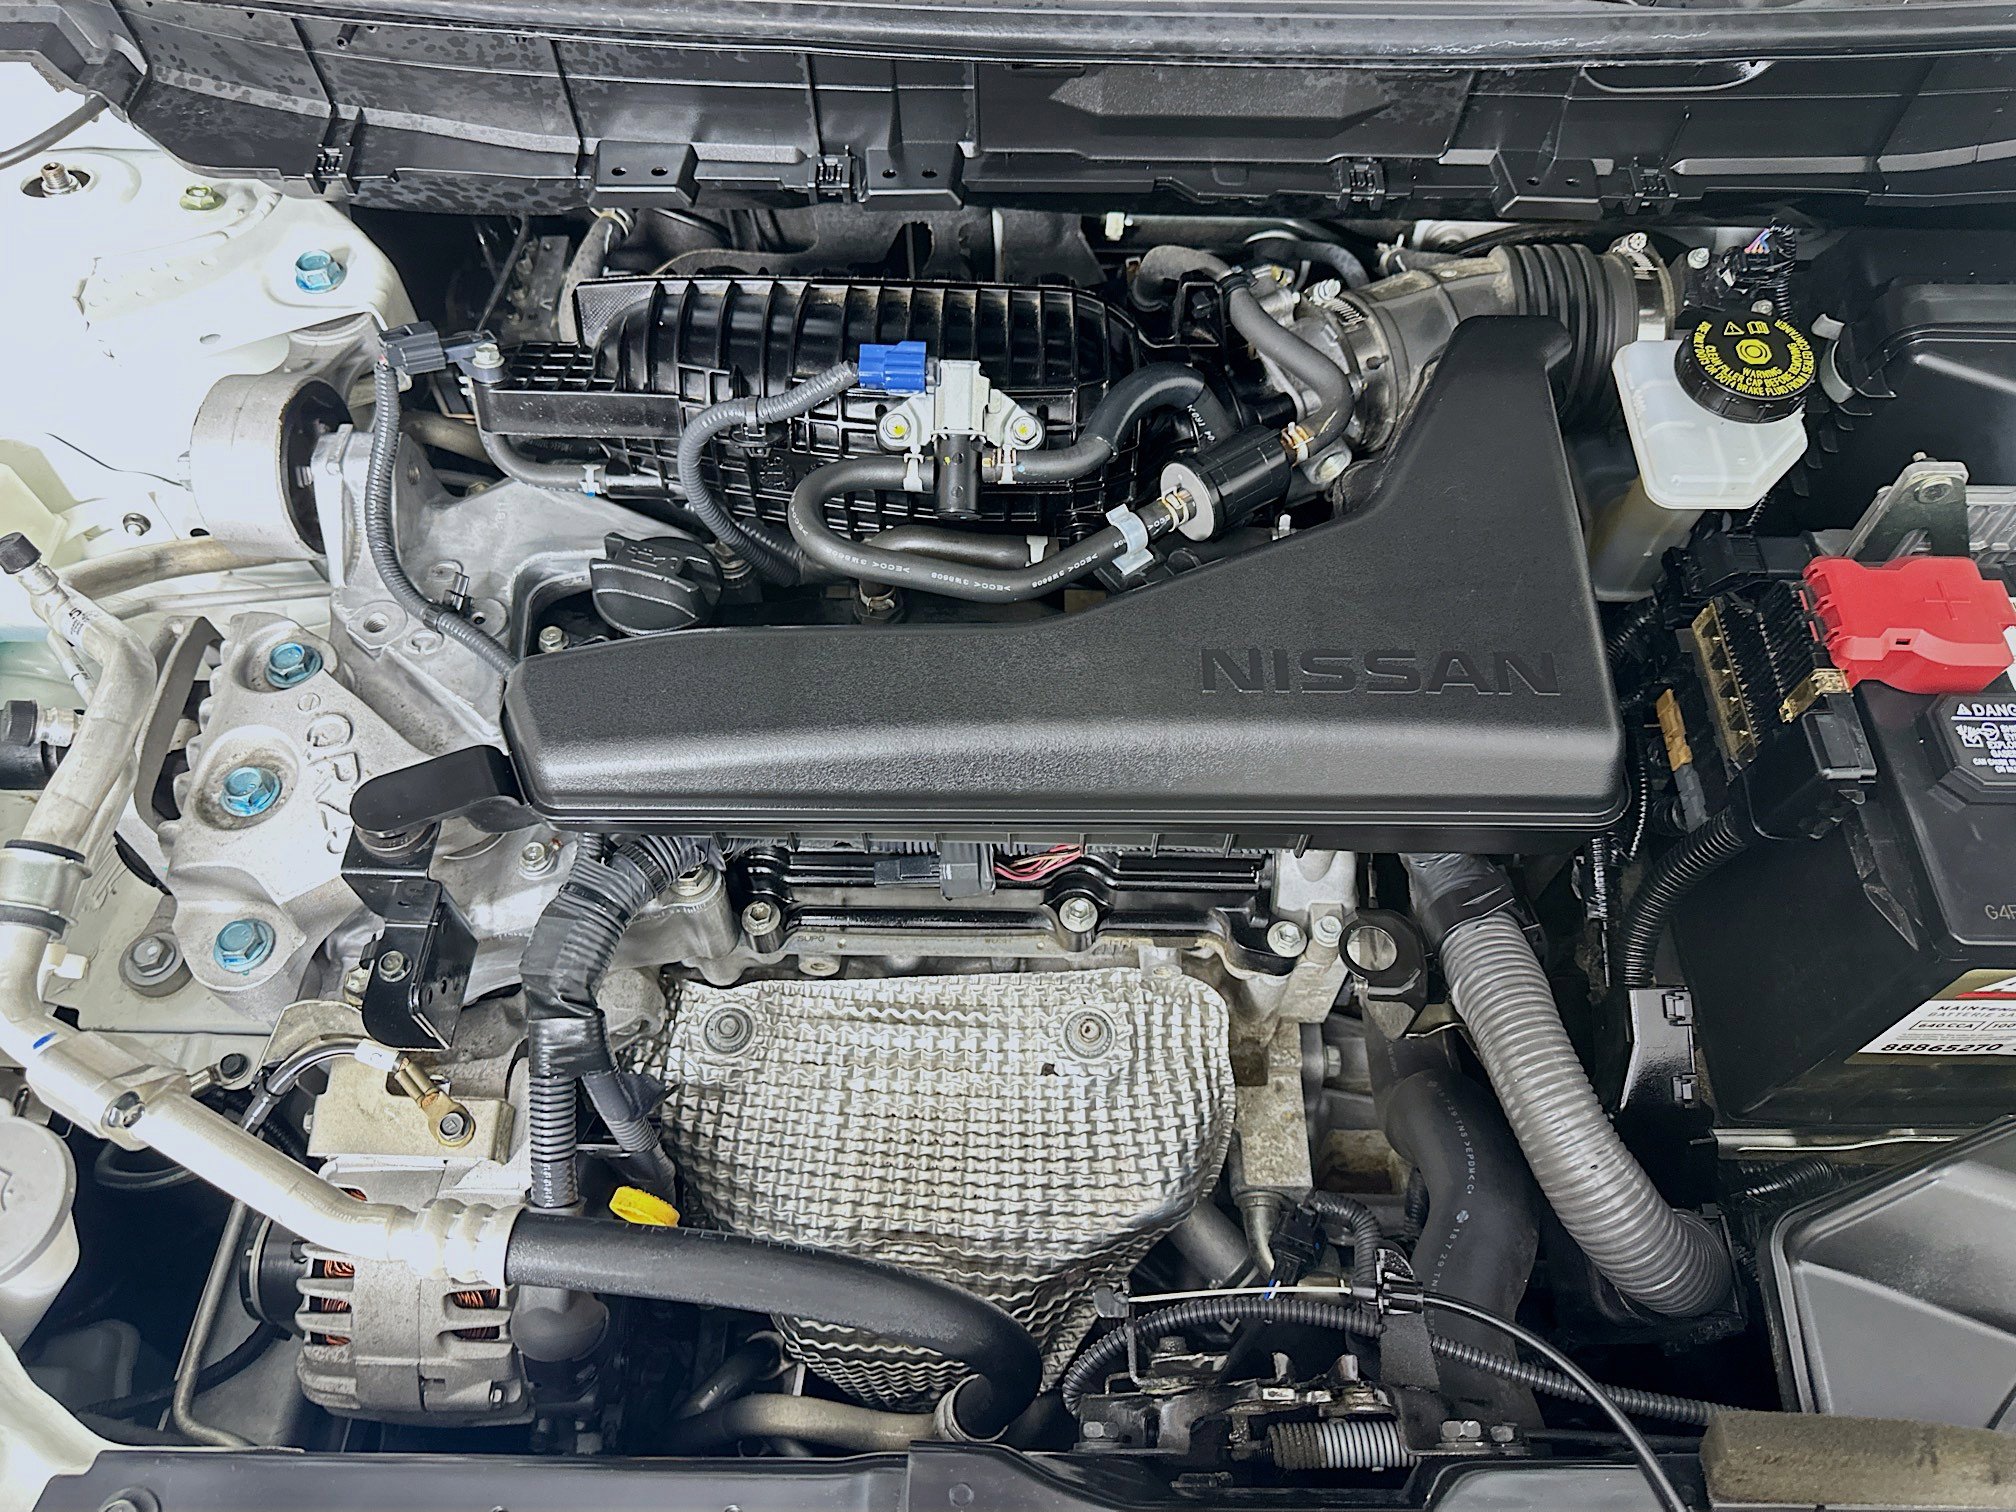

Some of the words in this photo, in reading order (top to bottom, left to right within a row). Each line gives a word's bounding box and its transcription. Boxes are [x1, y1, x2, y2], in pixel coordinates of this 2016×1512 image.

[1774, 318, 1810, 351] CONTAINER
[1694, 348, 1710, 365] DOT3
[1801, 350, 1814, 374] SEALED
[1704, 345, 1724, 367] CLEAN
[1717, 363, 1745, 384] FILLER
[1745, 377, 1763, 388] CAP
[1764, 371, 1795, 387] BEFORE
[1787, 343, 1803, 375] REMOVING
[1704, 364, 1719, 376] OR
[1742, 366, 1782, 379] WARNING
[1714, 373, 1736, 389] DOT4
[1786, 375, 1807, 391] FROM
[1736, 383, 1765, 396] BRAKE
[1765, 385, 1789, 396] FLUID
[1201, 648, 1561, 696] NISSAN
[1881, 1043, 2004, 1052] 88865270
